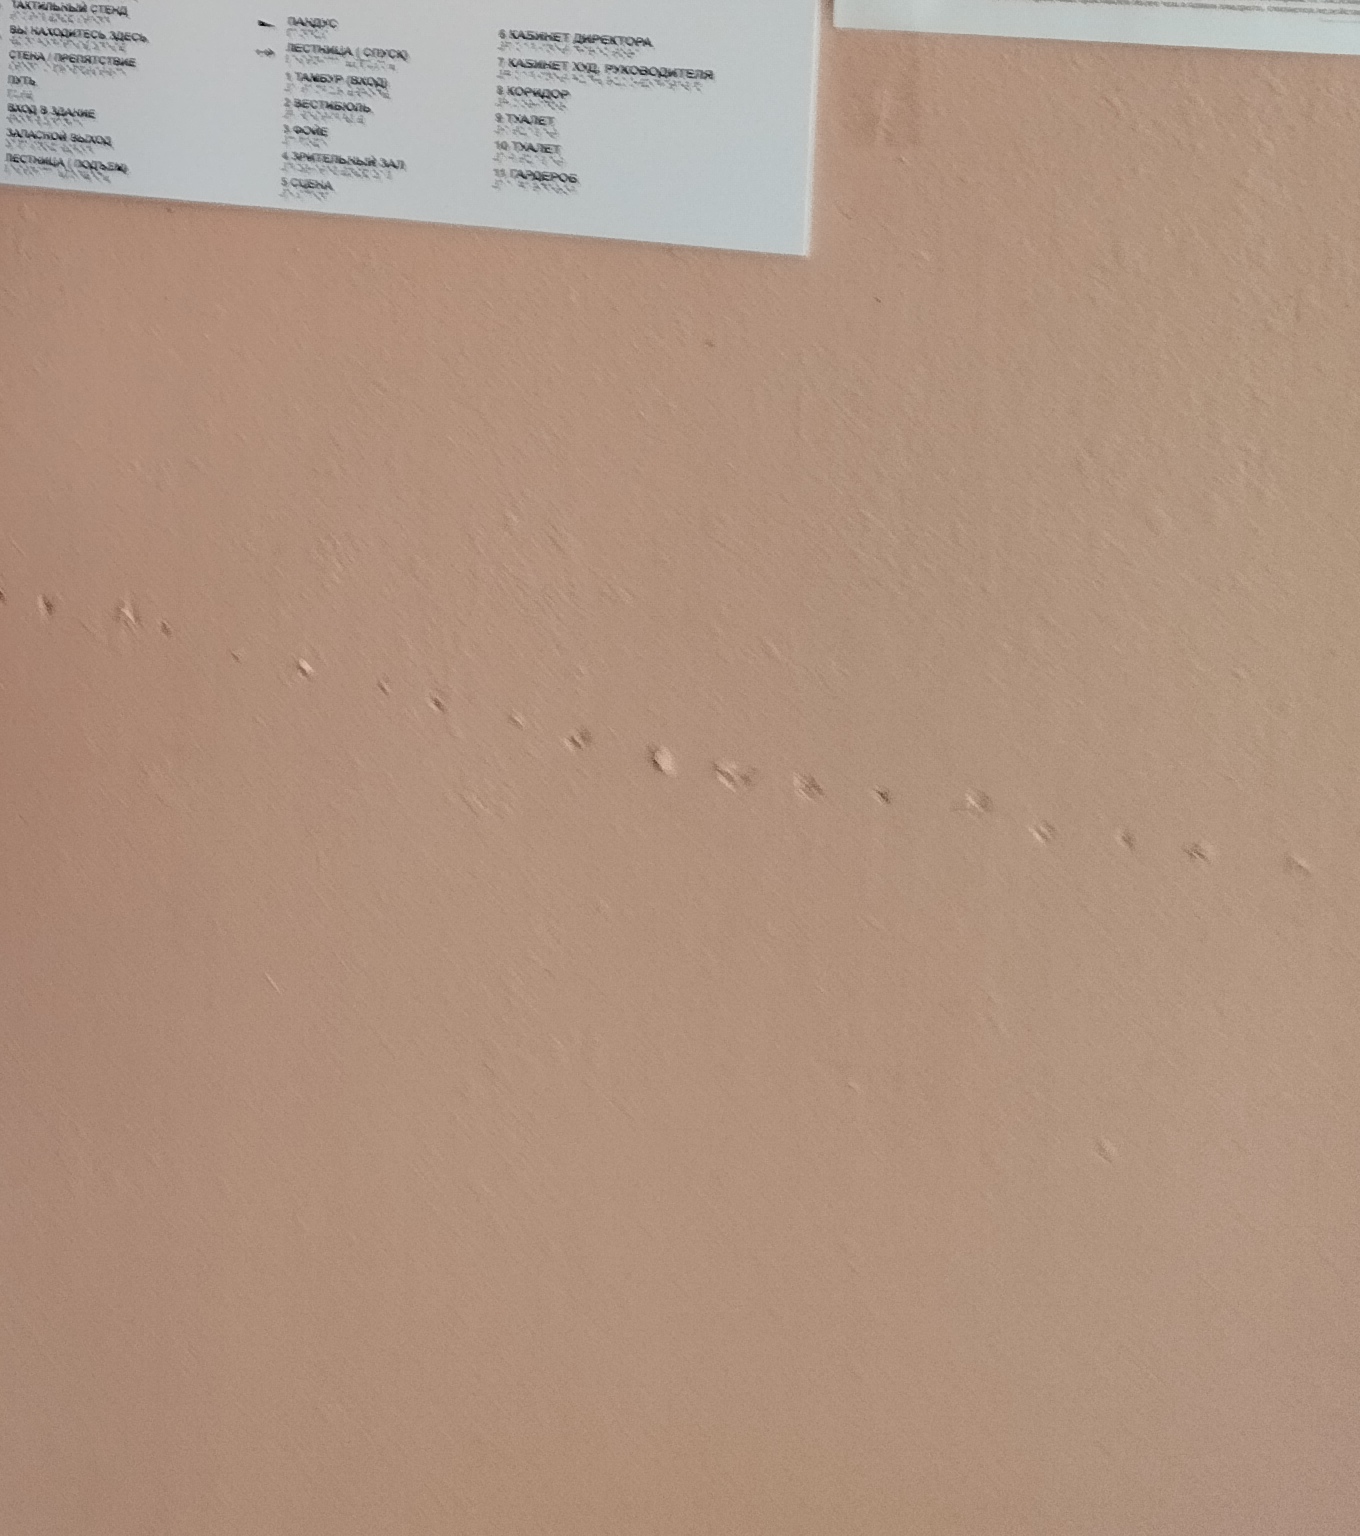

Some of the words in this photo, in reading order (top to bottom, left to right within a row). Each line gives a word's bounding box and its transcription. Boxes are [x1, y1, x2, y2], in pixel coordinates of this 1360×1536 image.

[11, 0, 88, 13] ТАКТИЛЬНЫЙ
[90, 5, 128, 16] СТЕНД
[30, 26, 106, 40] НАХОДИТЕСЬ
[509, 30, 570, 42] КАБИНЕТ
[573, 33, 654, 47] ДИРЕКТОРА
[8, 50, 46, 61] СТЕНА
[287, 43, 354, 57] ЛЕСТНИЦА
[508, 58, 568, 71] КАБИНЕТ
[604, 64, 714, 80] РУКОВОДИТЕЛЯ
[294, 71, 344, 84] ТАМБУР
[507, 86, 571, 99] КОРИДОР
[294, 99, 373, 113] ВЕСТИБЮЛЬ
[505, 114, 555, 126] ТУАЛЕТ
[6, 128, 67, 141] ЗАПАСНОЙ
[511, 142, 562, 154] ТУАЛЕТ
[380, 158, 406, 170] ЗАЛ
[509, 169, 579, 184] ГАРДЕРОБ
